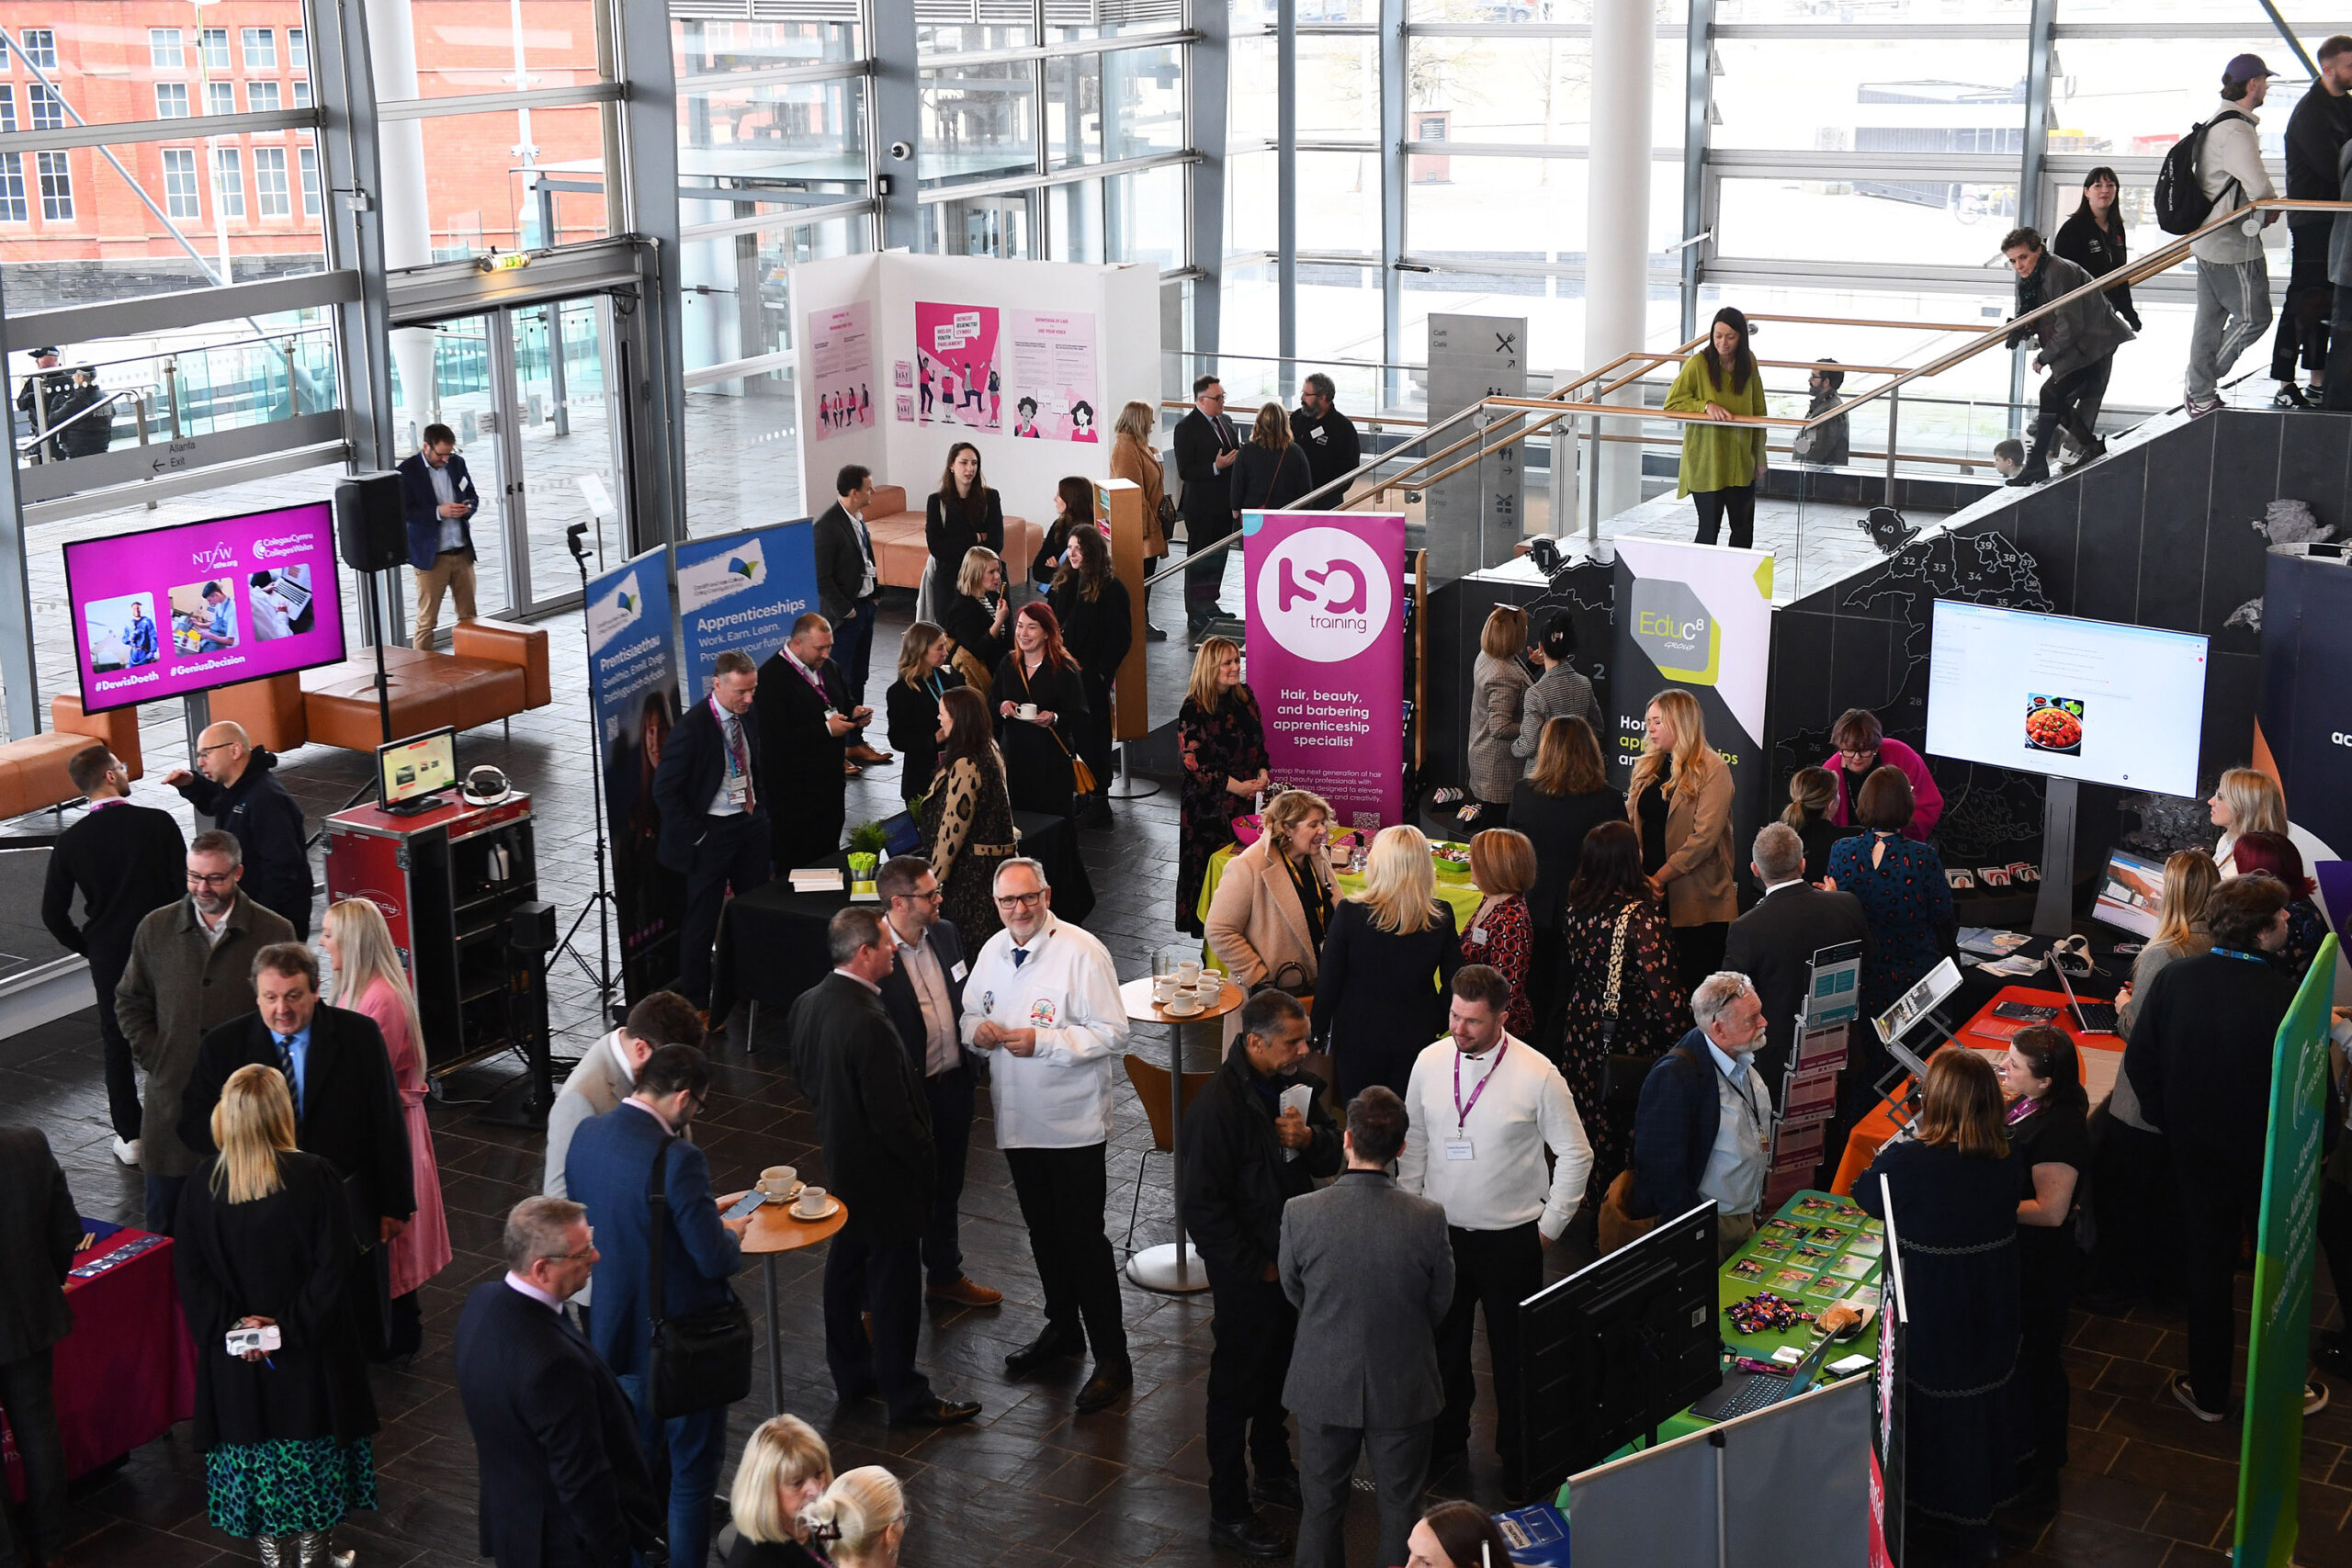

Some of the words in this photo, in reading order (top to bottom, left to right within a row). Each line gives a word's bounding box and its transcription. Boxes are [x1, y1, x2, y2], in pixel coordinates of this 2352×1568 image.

[170, 457, 186, 468] Exit
[1880, 525, 1894, 534] 40
[1979, 542, 1992, 550] 39
[1543, 549, 1550, 565] 1
[1903, 557, 1916, 566] 32
[2003, 554, 2016, 563] 38
[1933, 563, 1947, 572] 33
[1968, 572, 1982, 581] 34
[1996, 598, 2008, 606] 35
[697, 599, 806, 633] Apprenticeships
[1310, 615, 1366, 634] training
[1664, 642, 1695, 651] GROUP
[170, 655, 246, 677] #GeniusDecision
[1593, 663, 1605, 680] 2
[96, 671, 159, 692] #DewisDoeth
[1281, 689, 1309, 701] Hair,
[1313, 690, 1363, 704] beauty,
[1909, 697, 1922, 705] 28
[1277, 705, 1302, 715] and
[1306, 705, 1369, 720] barbering
[1273, 720, 1370, 735] apprenticeship
[1294, 735, 1353, 747] specialist
[1808, 743, 1821, 751] 26
[1315, 777, 1357, 785] professionals
[1317, 784, 1348, 794] designed
